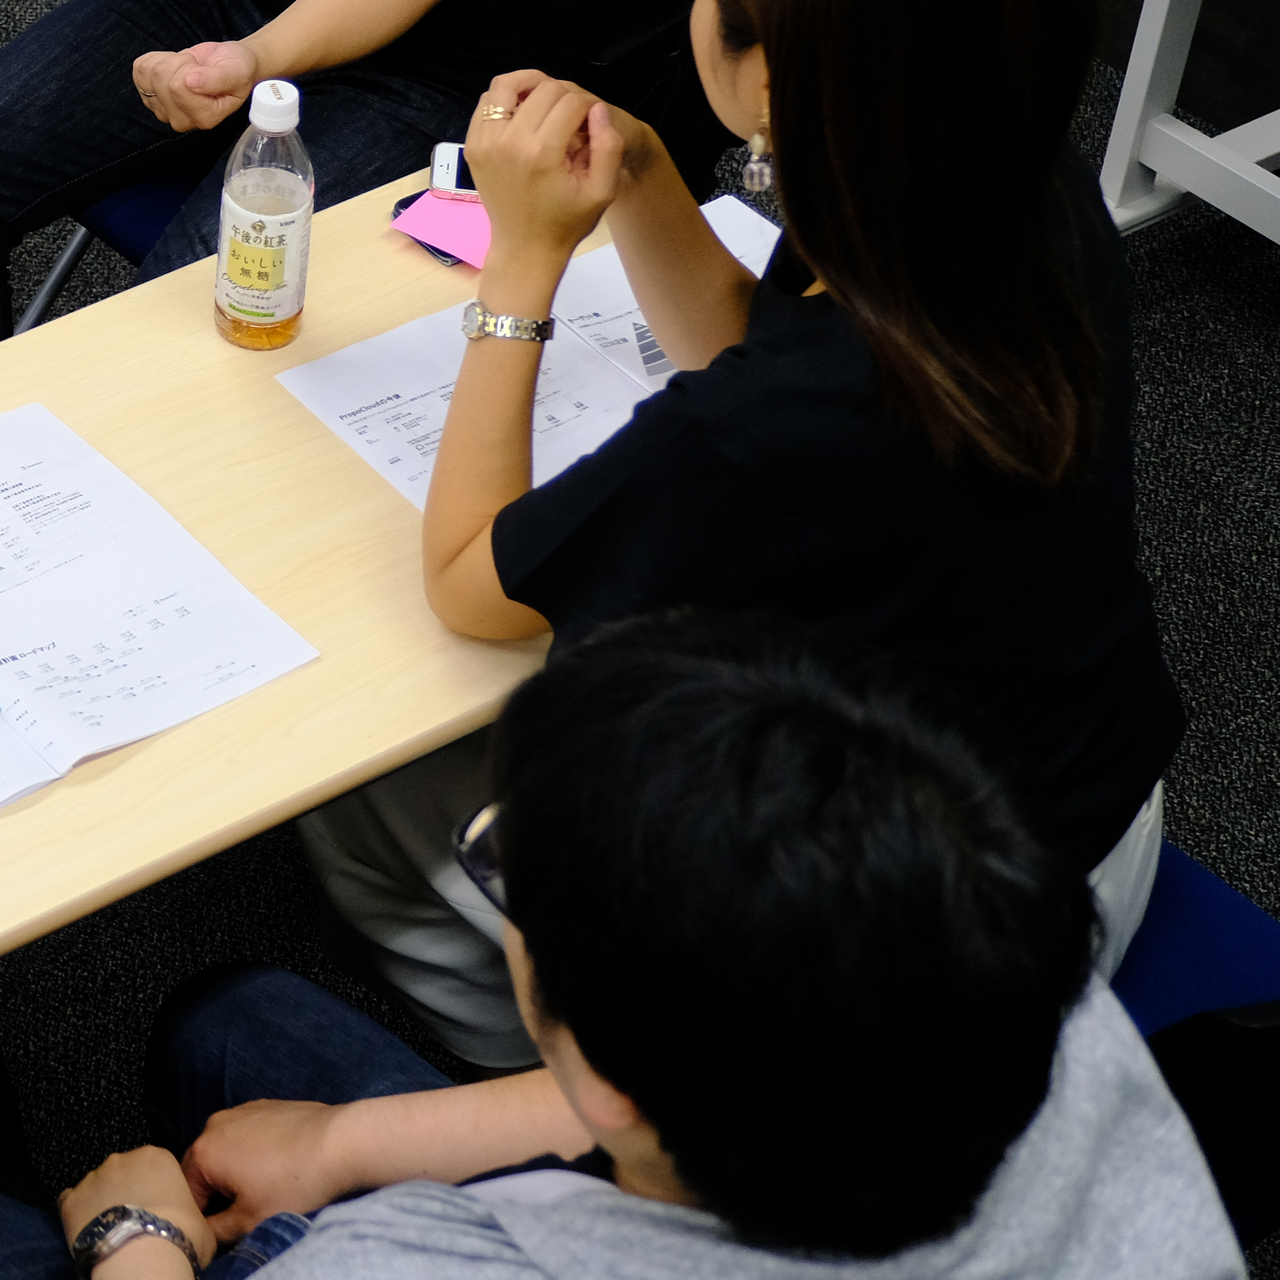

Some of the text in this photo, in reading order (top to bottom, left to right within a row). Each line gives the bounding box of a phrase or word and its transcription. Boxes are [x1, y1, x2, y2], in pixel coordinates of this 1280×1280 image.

[269, 81, 281, 102] KIRIN
[279, 219, 295, 227] KIRIN
[229, 224, 288, 249] 午後の紅茶
[229, 248, 283, 269] おいしい
[239, 266, 270, 281] 無糖
[18, 641, 56, 659] ロードマップ
